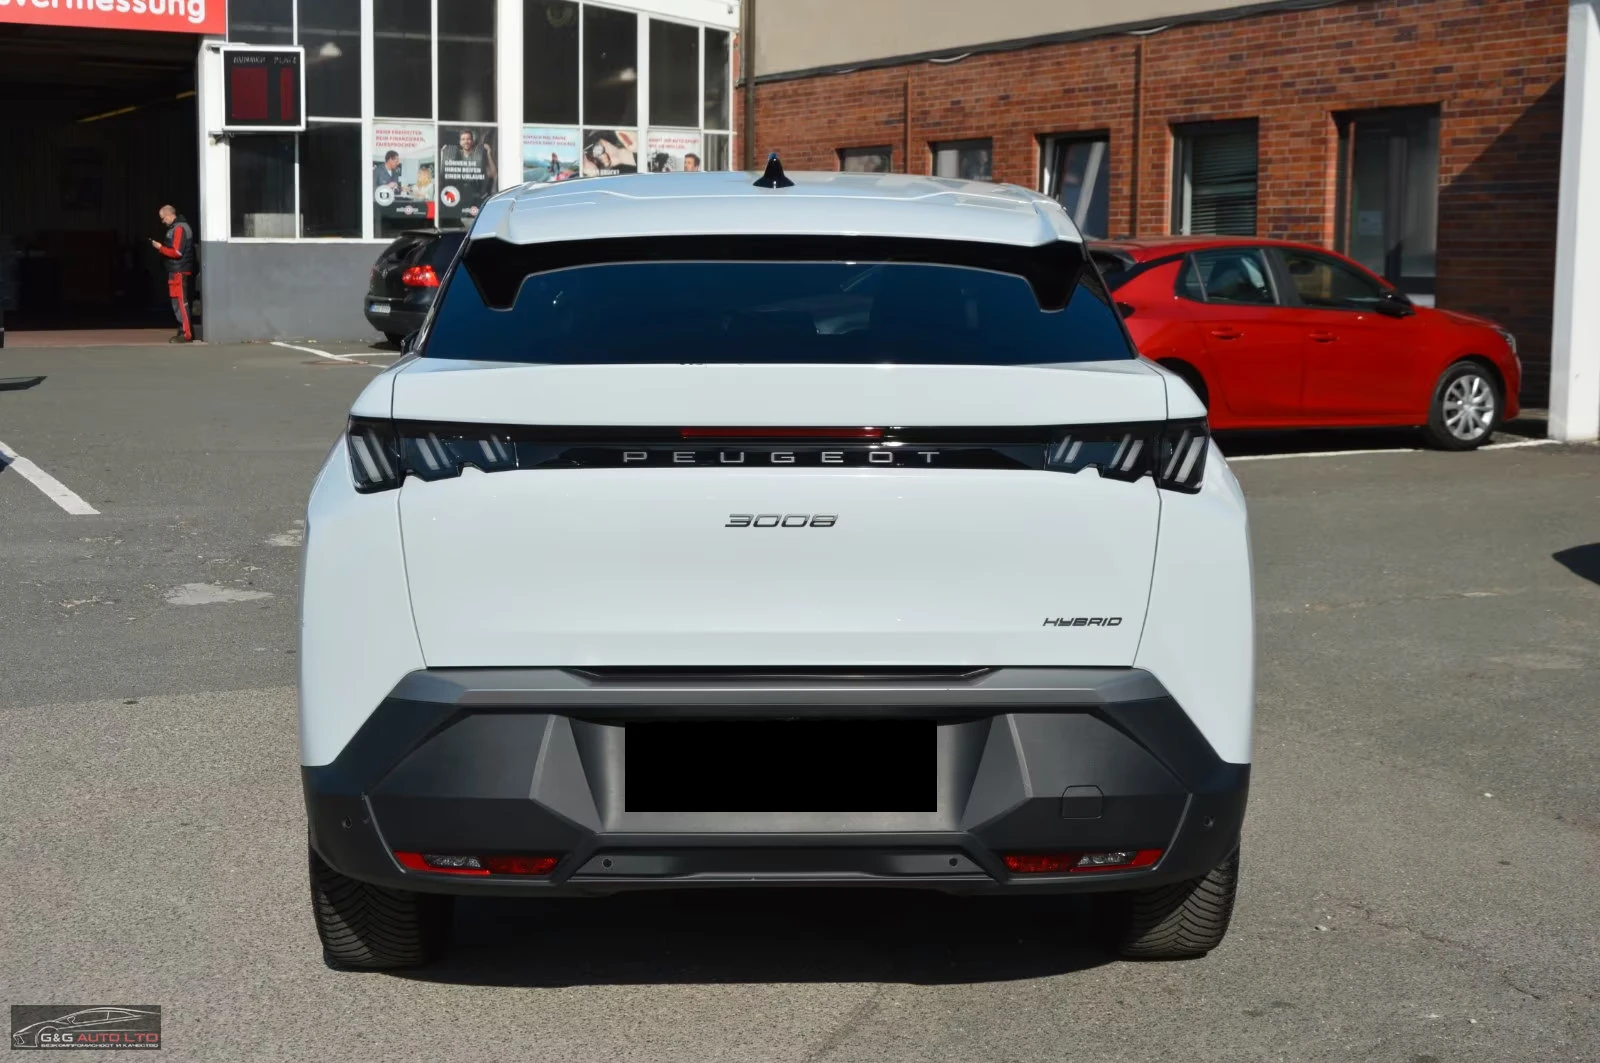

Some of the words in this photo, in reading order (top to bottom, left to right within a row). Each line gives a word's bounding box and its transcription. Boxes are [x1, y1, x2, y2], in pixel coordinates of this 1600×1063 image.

[622, 451, 941, 464] PEUGEOT
[724, 512, 839, 528] 3008
[1042, 617, 1123, 627] HYBRID
